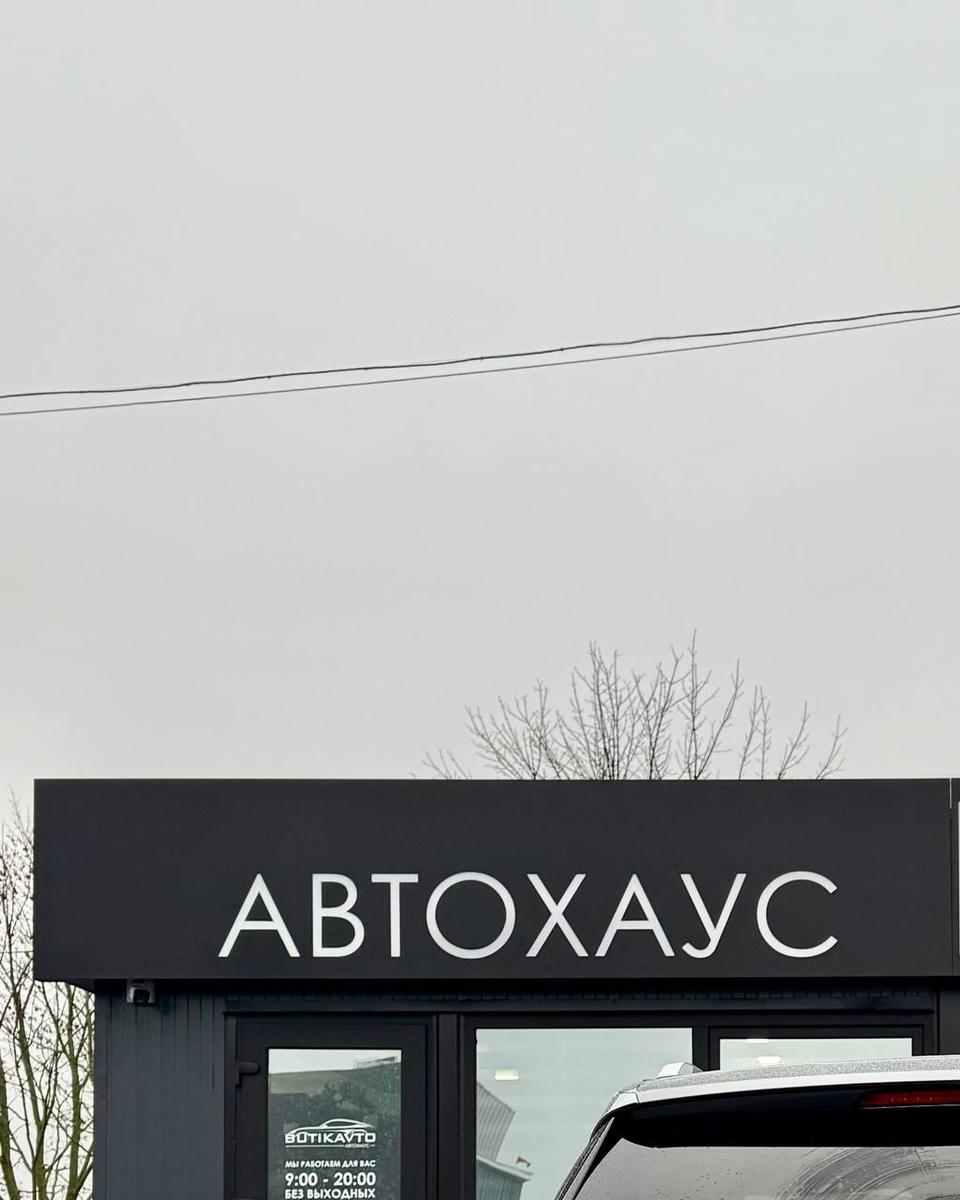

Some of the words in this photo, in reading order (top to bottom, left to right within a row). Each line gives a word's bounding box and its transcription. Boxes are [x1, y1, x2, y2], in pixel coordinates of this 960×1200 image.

[217, 870, 838, 960] АВТОХАУС
[284, 1132, 376, 1144] BUTIKAVTO
[285, 1160, 299, 1168] МЫ
[300, 1160, 340, 1168] РАБОТАЕМ
[342, 1160, 358, 1168] ДЛЯ
[360, 1160, 376, 1168] ВАС
[285, 1172, 318, 1187] 9:00
[333, 1171, 377, 1187] 20:00
[285, 1188, 304, 1199] БЕЗ
[307, 1188, 376, 1200] ВЫХОДНЫХ
